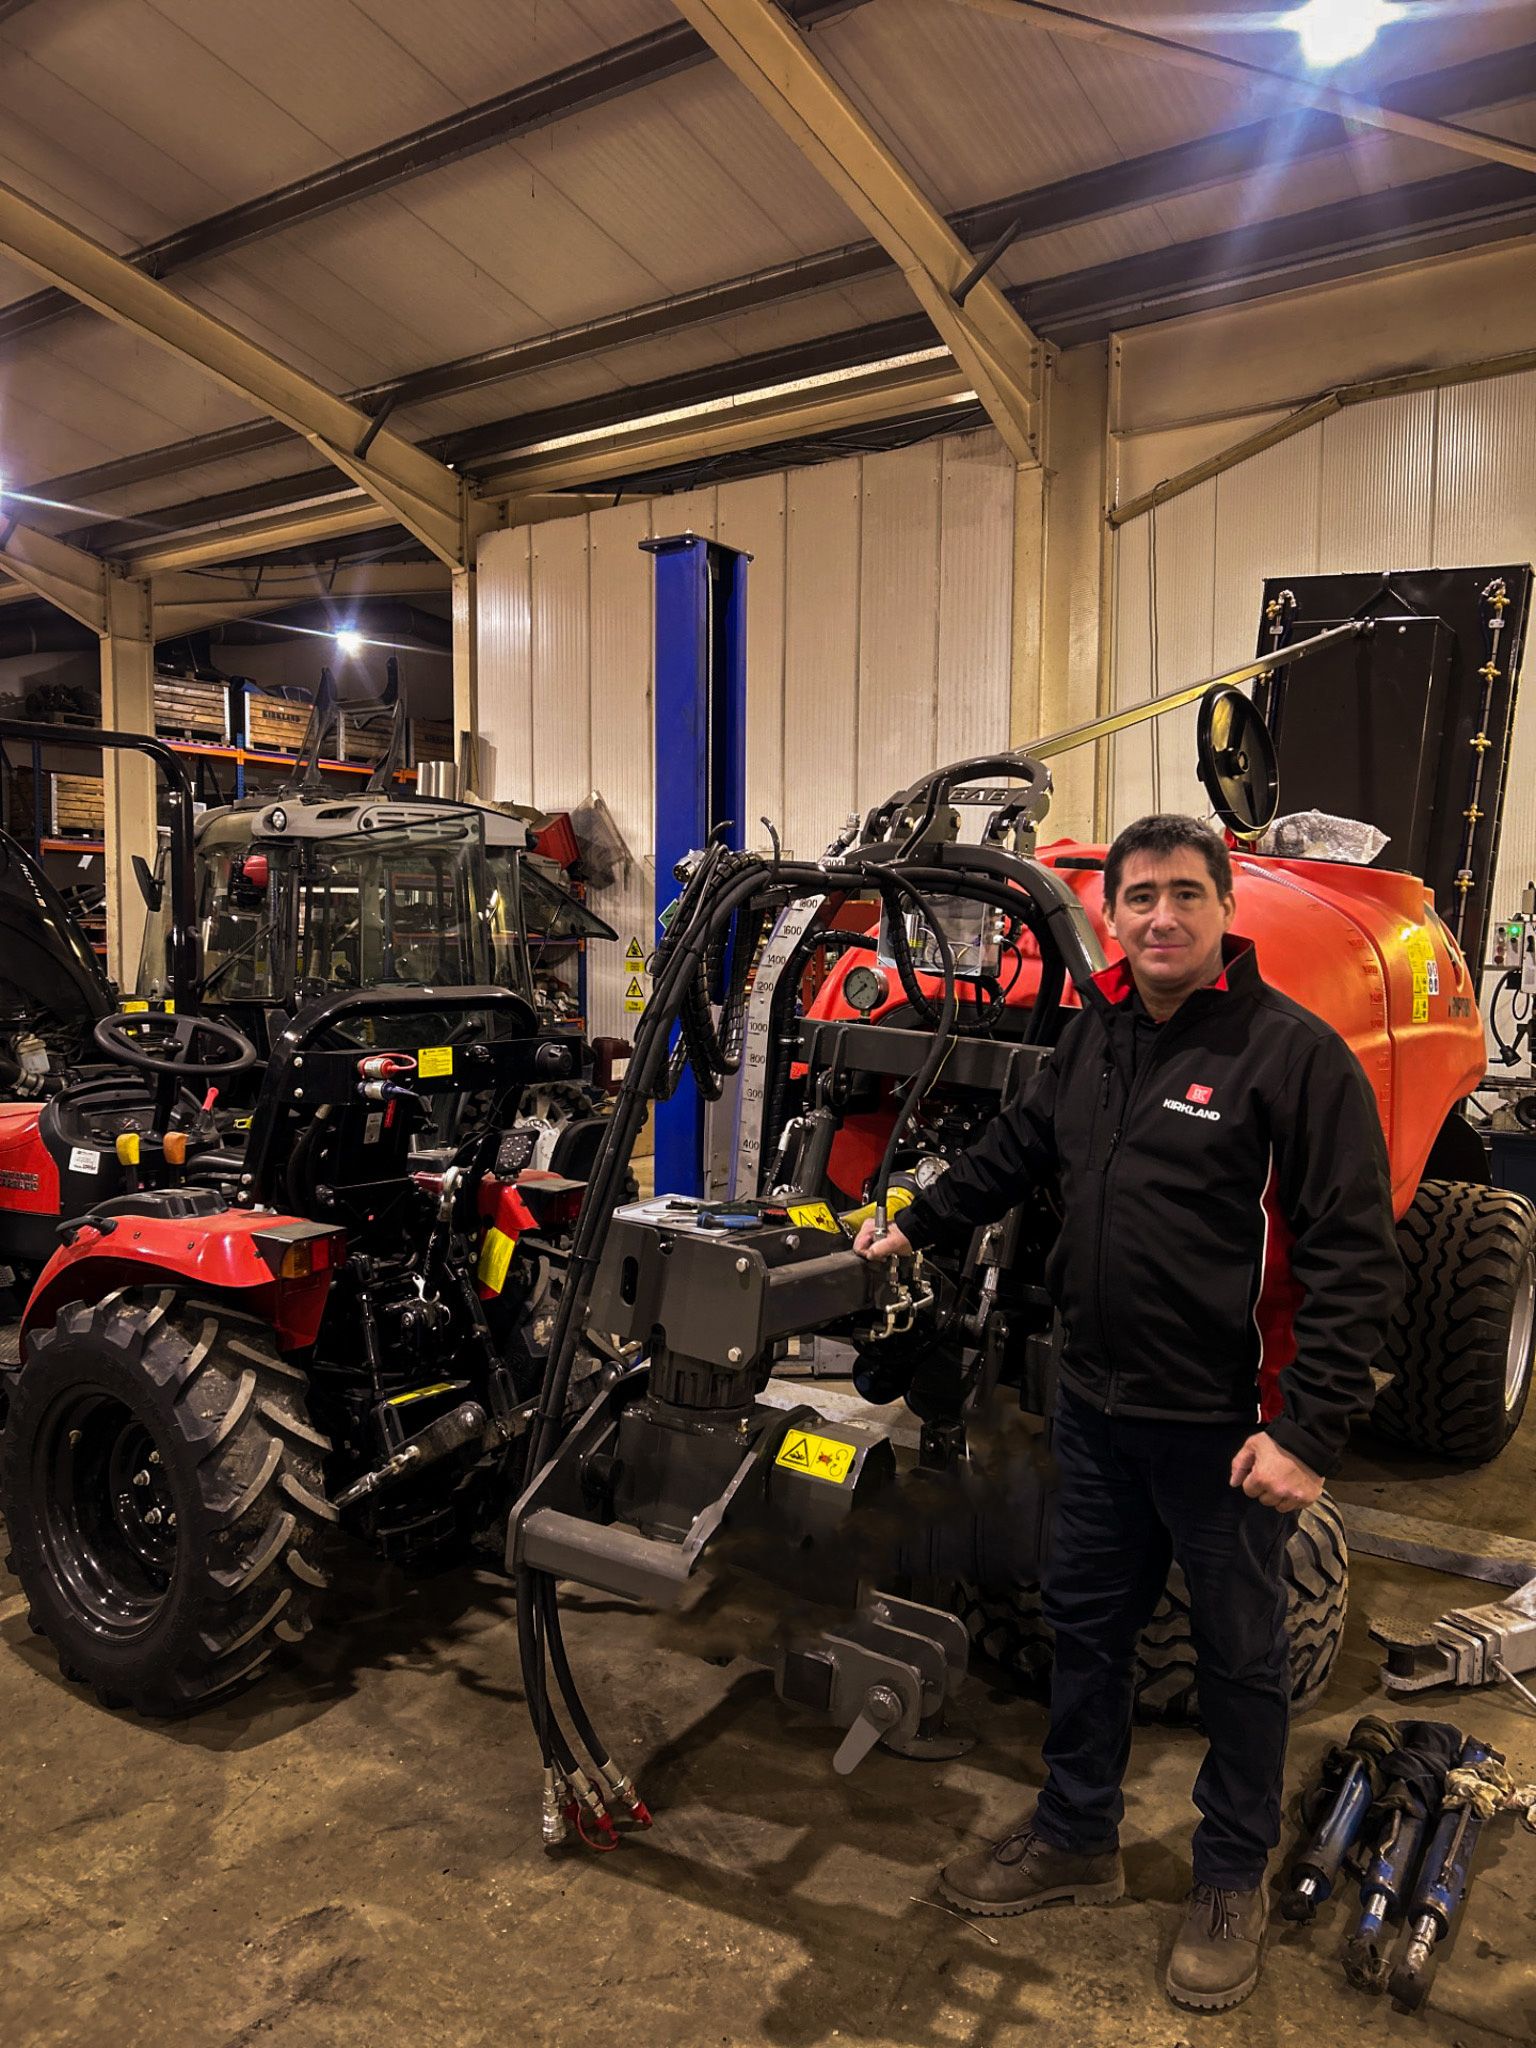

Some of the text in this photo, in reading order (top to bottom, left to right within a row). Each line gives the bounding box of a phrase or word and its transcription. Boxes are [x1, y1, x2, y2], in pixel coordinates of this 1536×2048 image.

[799, 899, 818, 909] 1800
[783, 925, 803, 936] 1600
[768, 954, 787, 965] 1400
[757, 981, 774, 992] 1200
[749, 1022, 768, 1033] 1000
[749, 1053, 766, 1064] 800
[747, 1087, 763, 1099] 600
[1162, 1098, 1221, 1121] KIRKLAND
[742, 1139, 760, 1151] 400
